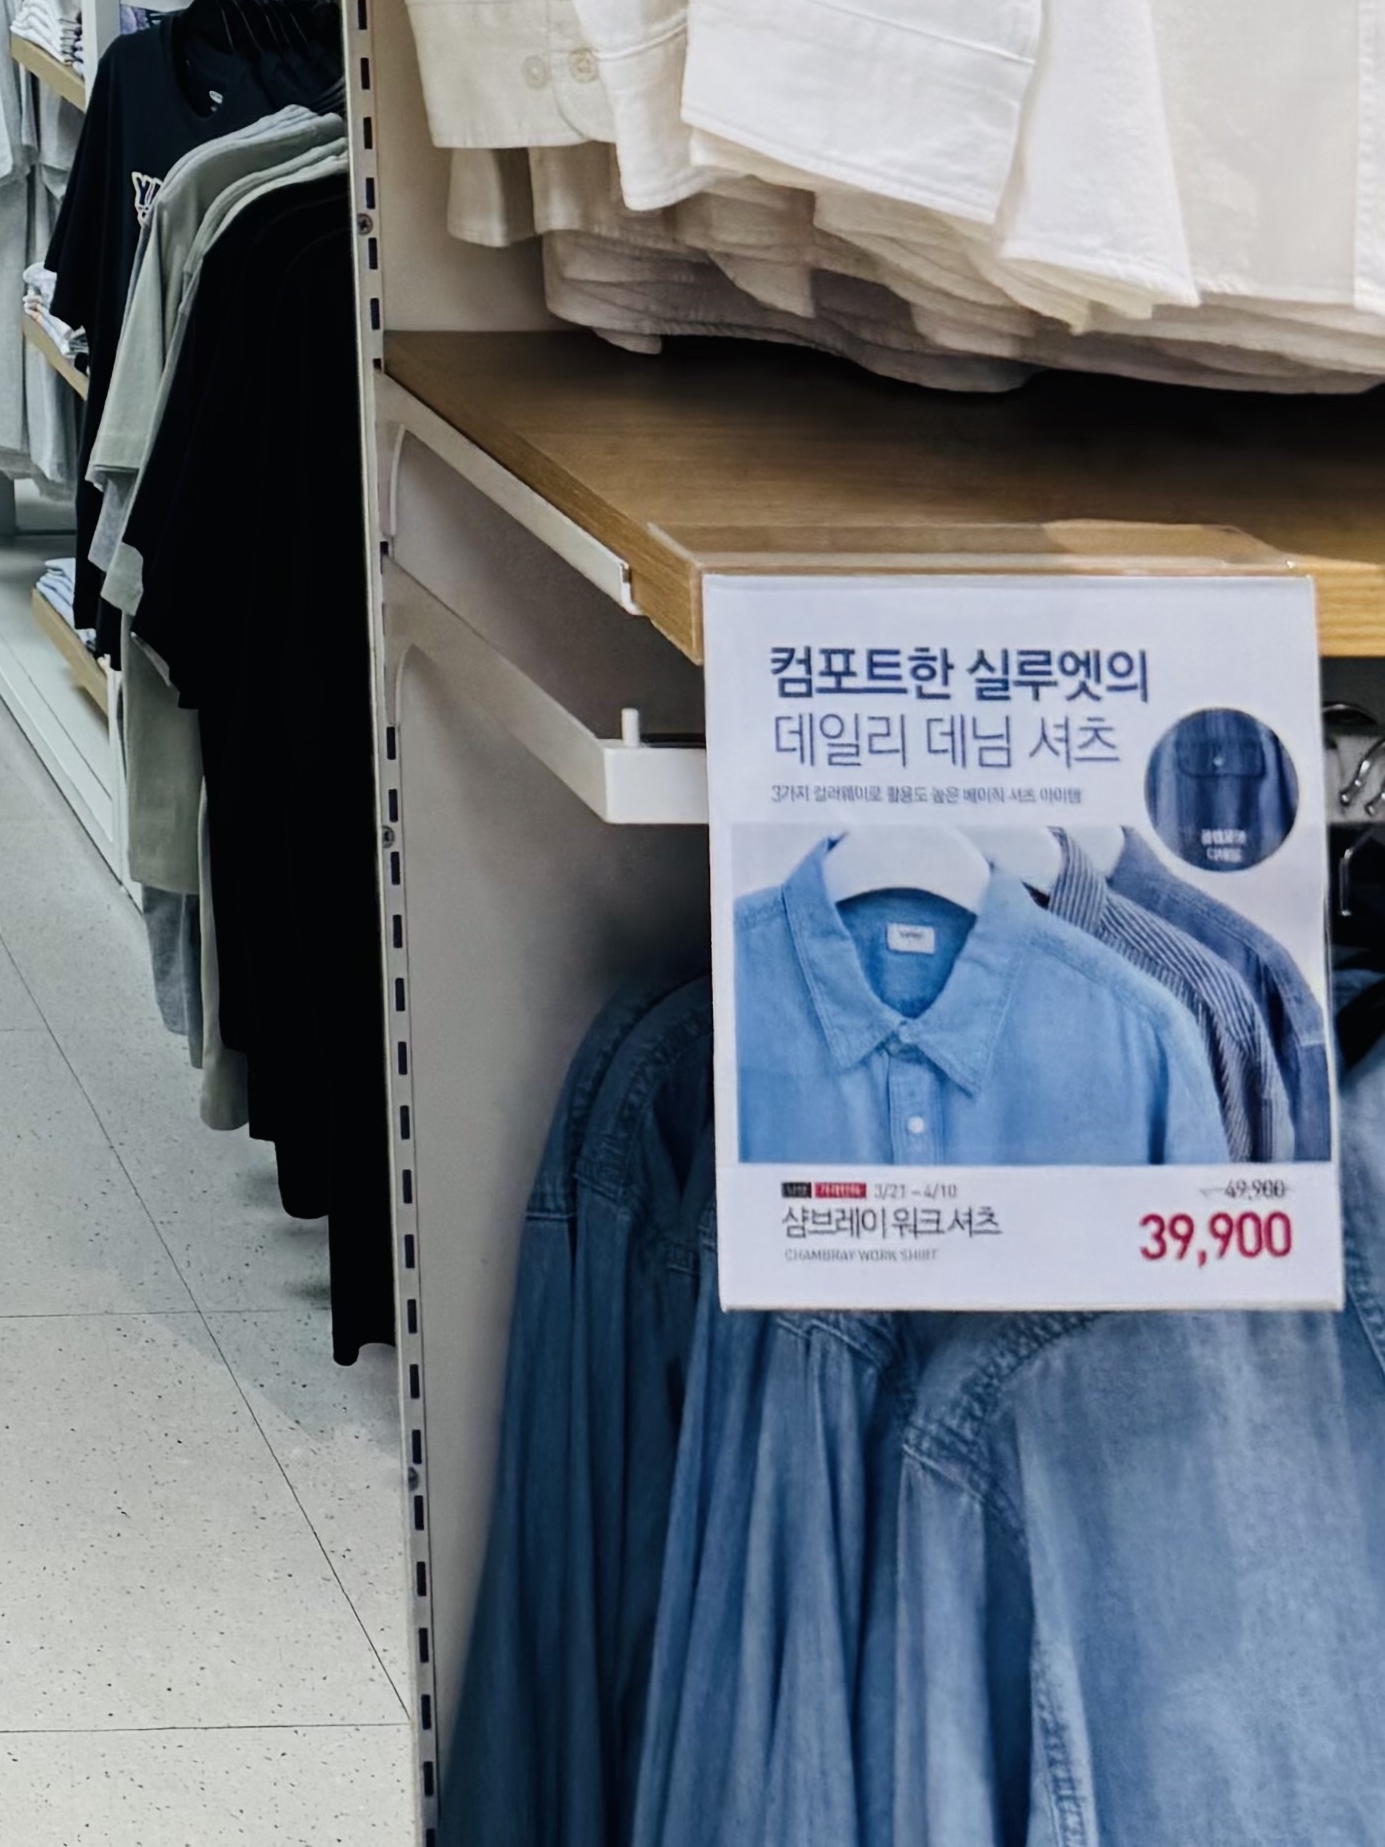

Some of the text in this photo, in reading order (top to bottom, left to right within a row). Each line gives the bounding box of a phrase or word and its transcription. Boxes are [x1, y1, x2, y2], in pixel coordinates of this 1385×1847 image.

[770, 646, 1149, 703] 컴포트한 실루엣의
[774, 713, 1121, 769] 데일리 데님 셔츠
[770, 785, 809, 803] 3가지
[874, 1183, 906, 1199] 3/21
[923, 1183, 958, 1199] 4/10
[1224, 1179, 1286, 1200] 49,900
[782, 1206, 1003, 1239] 샴브레이 워크 셔츠
[1140, 1211, 1292, 1268] 39,900
